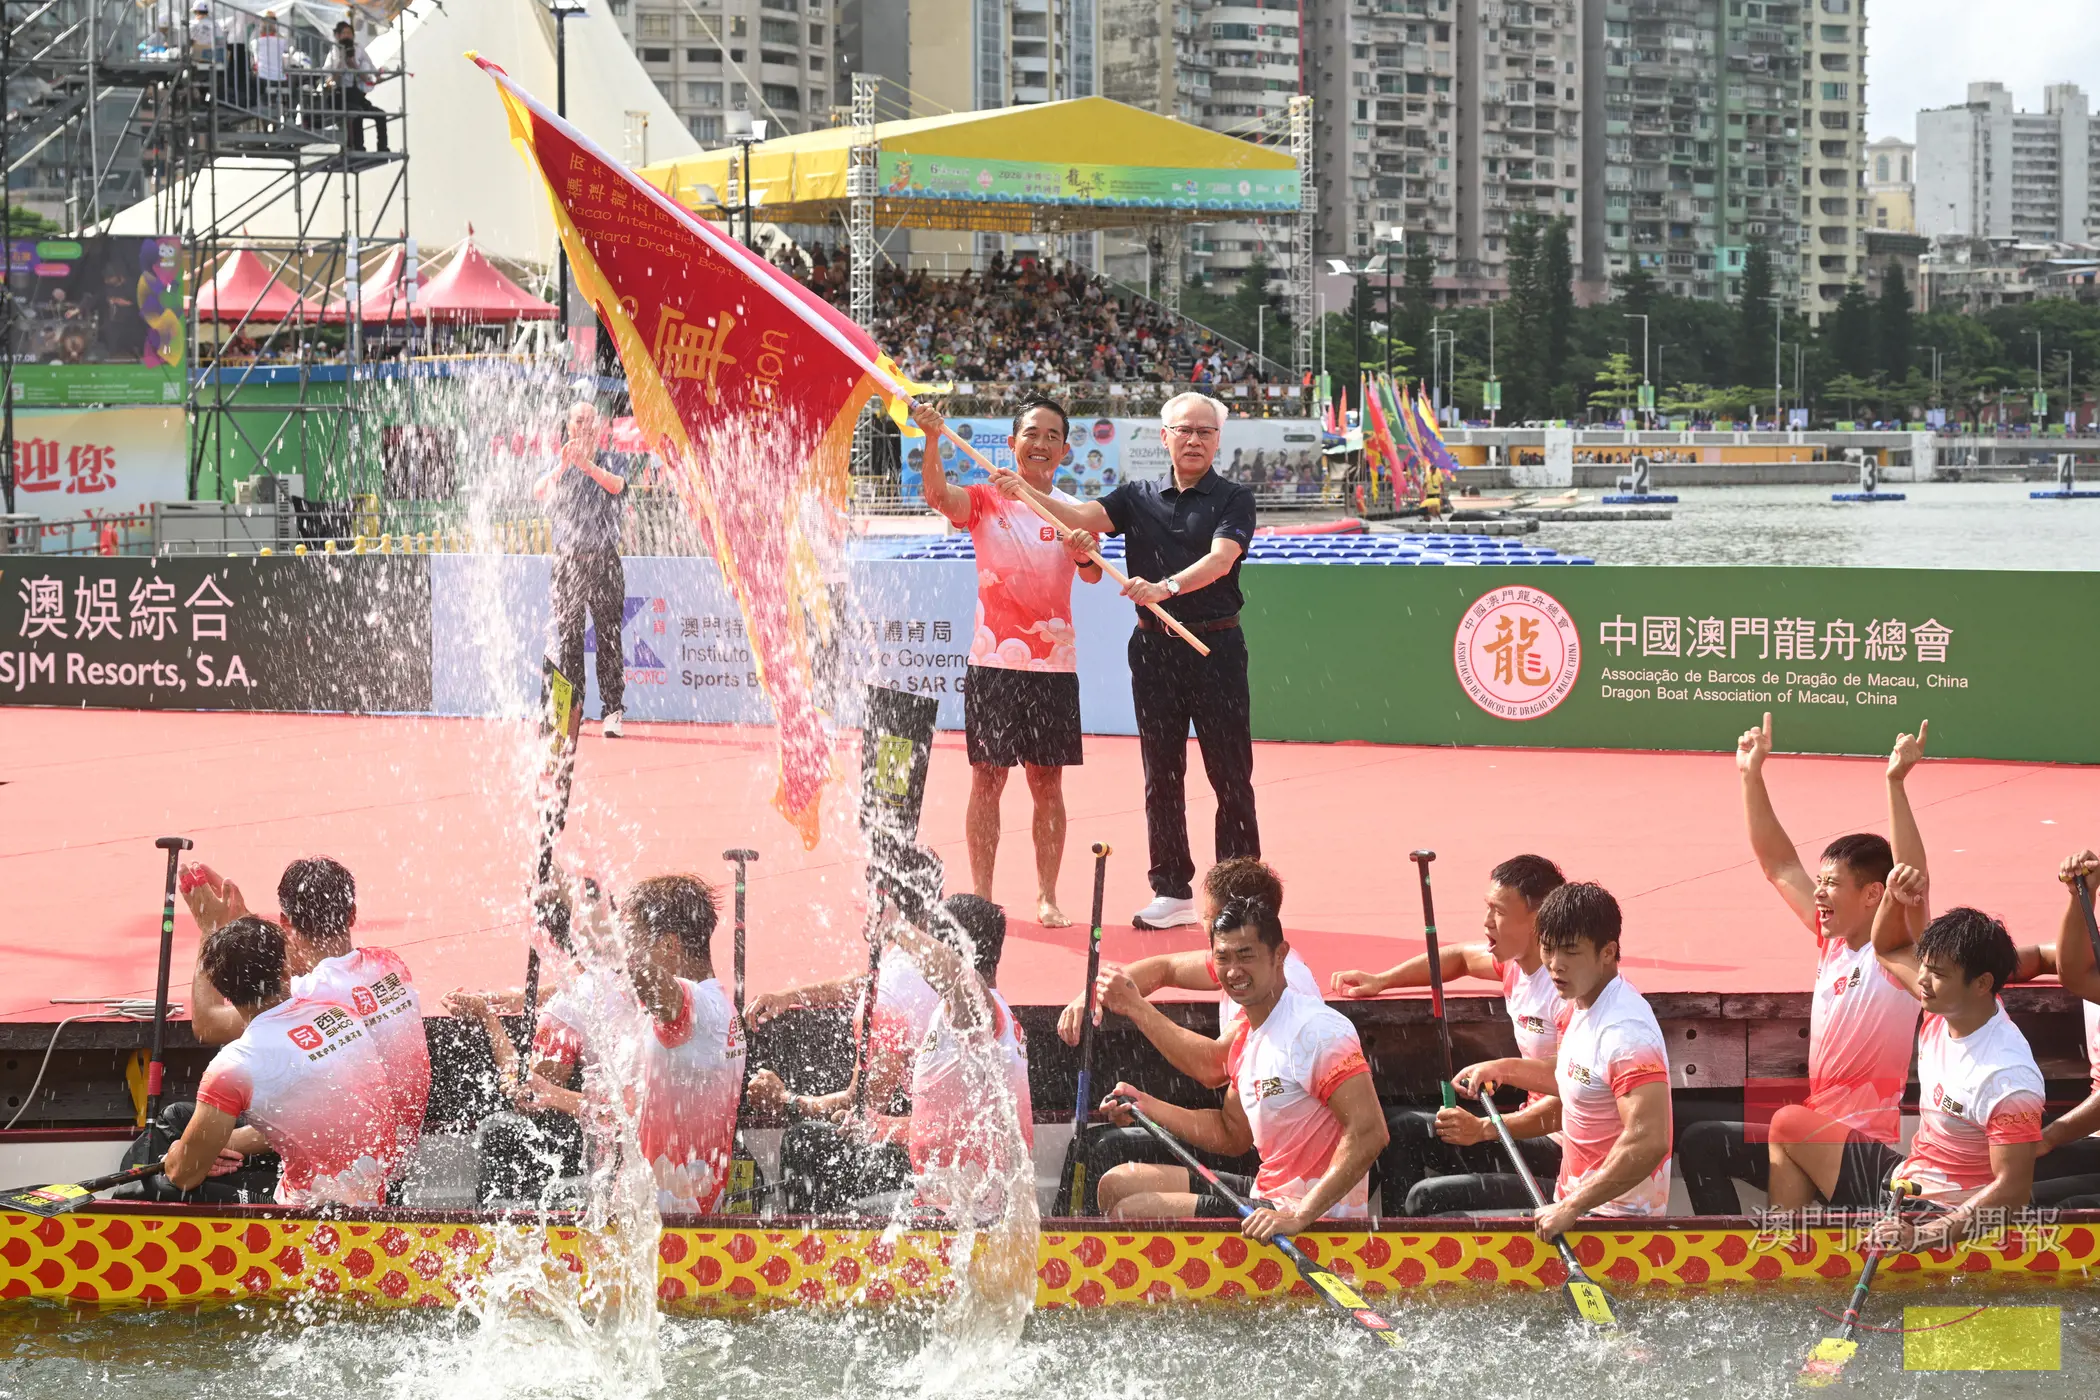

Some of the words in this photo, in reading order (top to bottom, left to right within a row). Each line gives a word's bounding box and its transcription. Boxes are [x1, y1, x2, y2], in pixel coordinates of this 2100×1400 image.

[576, 226, 631, 245] andard
[636, 237, 692, 262] Dragon
[697, 252, 735, 277] Boat
[1634, 457, 1648, 495] 2
[1863, 455, 1877, 493] 3
[2059, 454, 2074, 490] 4
[18, 574, 235, 641] 澳娛綜合
[1482, 614, 1552, 687] 龍
[1600, 614, 1954, 663] 中國澳門龍舟總會
[0, 651, 55, 692] SJM
[66, 652, 187, 692] Resorts,
[196, 654, 258, 687] S.A.
[682, 670, 740, 690] Sports
[907, 675, 947, 693] SAR
[1601, 667, 1679, 685] Associação
[1684, 670, 1702, 683] de
[1708, 670, 1756, 684] Barcos
[1762, 671, 1780, 684] de
[1785, 672, 1837, 688] Dragão
[1843, 673, 1861, 686] de
[1867, 673, 1920, 689] Macau,
[1926, 674, 1969, 688] China
[1601, 685, 1651, 702] Dragon
[1657, 686, 1689, 700] Boat
[1693, 687, 1772, 702] Association
[1777, 689, 1793, 703] of
[1798, 690, 1849, 706] Macau,
[1856, 691, 1898, 705] China
